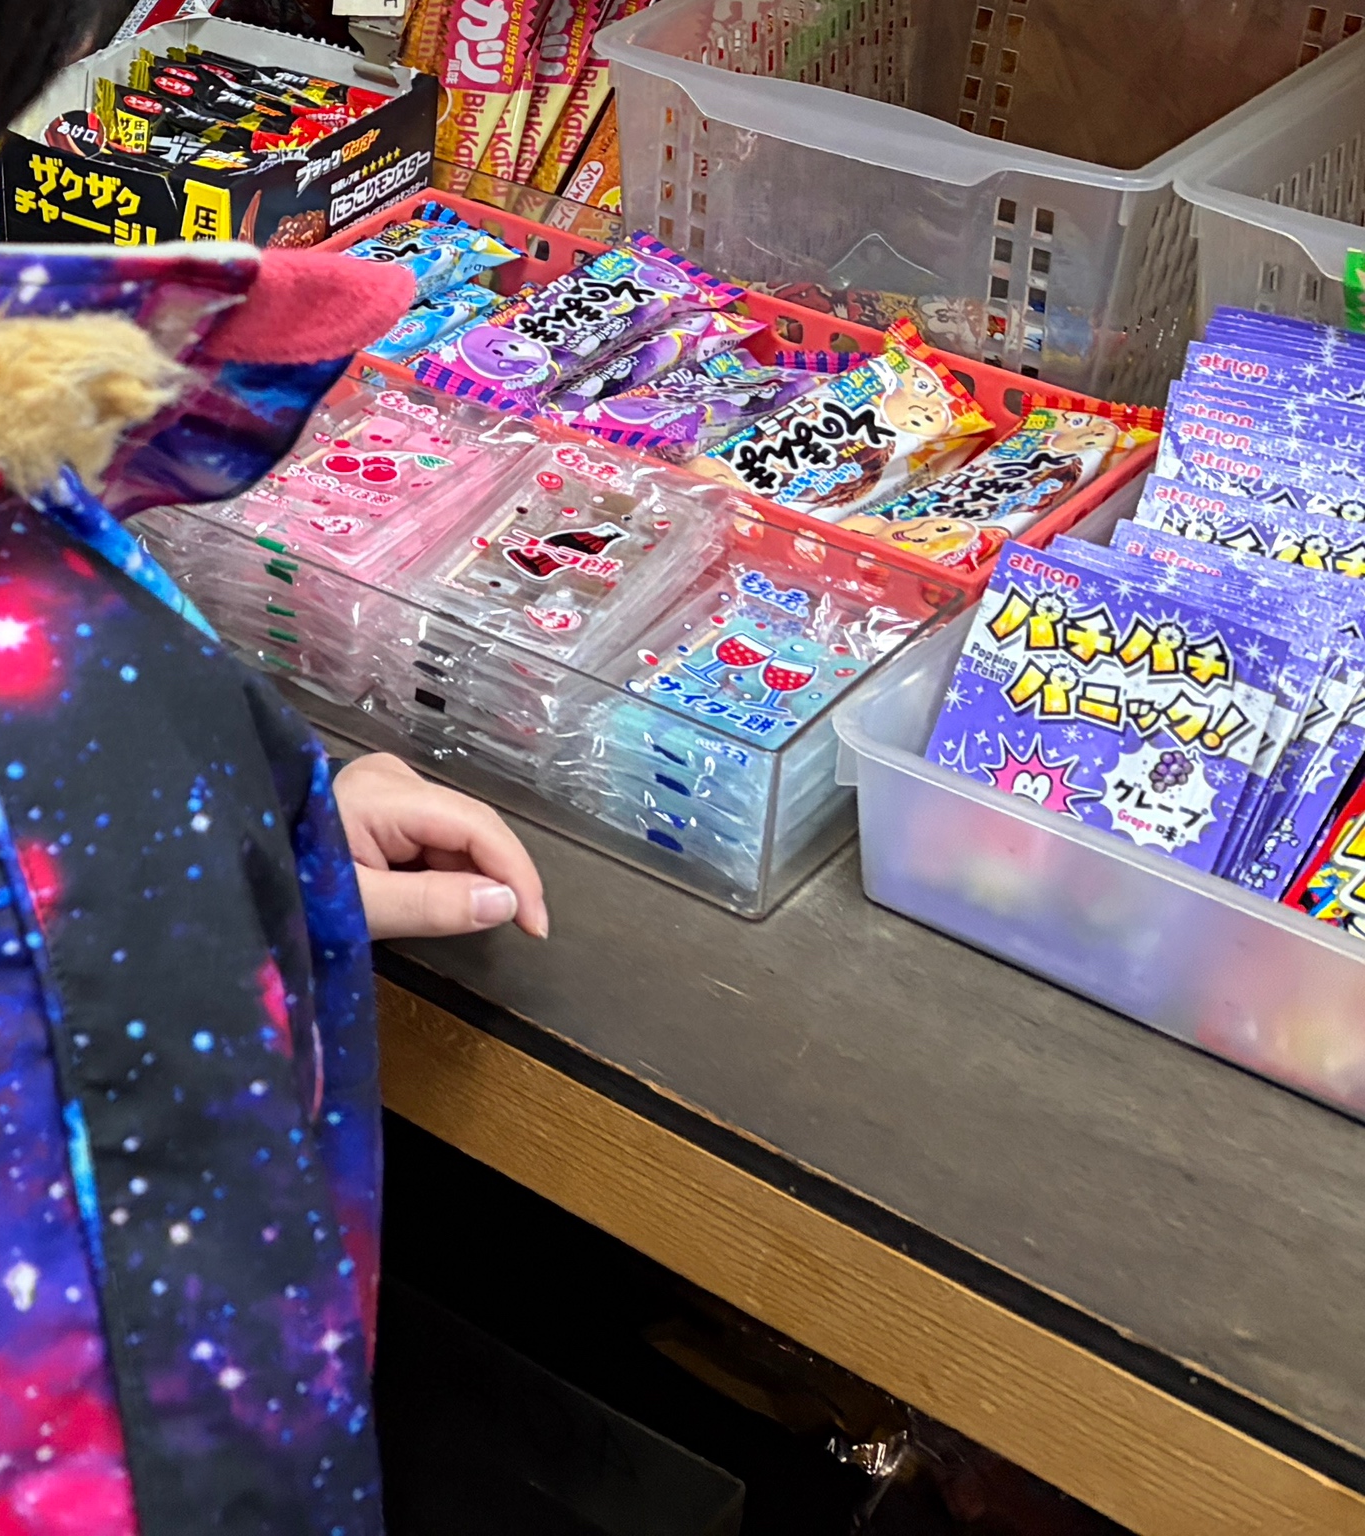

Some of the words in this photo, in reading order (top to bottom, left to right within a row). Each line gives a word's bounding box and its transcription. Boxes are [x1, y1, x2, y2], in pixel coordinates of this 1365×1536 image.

[123, 94, 164, 114] ユーラク
[154, 76, 195, 97] ユーラク
[56, 120, 99, 144] あけ口
[556, 66, 599, 165] BigKatsu
[28, 153, 141, 216] ザクザク
[329, 150, 432, 226] にっこりモンスター
[14, 186, 158, 247] チャージ!
[525, 274, 577, 311] グレープ
[512, 275, 659, 348] そのまんま
[1197, 352, 1269, 379] atrion
[753, 391, 819, 438] コーラ
[1183, 402, 1254, 429] atrion
[730, 399, 899, 496] そのまんま
[1180, 421, 1251, 451] atrion
[1191, 448, 1262, 479] atrion
[926, 448, 1079, 523] そのまんま
[1154, 483, 1227, 514] atrion
[1007, 552, 1081, 590] atrion
[985, 584, 1235, 688] パチパチ
[969, 641, 1018, 674] Popping
[972, 662, 1009, 685] Panic
[652, 673, 777, 735] サイダー餅
[1001, 657, 1251, 750] パニック!
[1113, 779, 1210, 829] グレープ
[1117, 808, 1153, 833] Grape
[1155, 822, 1179, 843] 味
